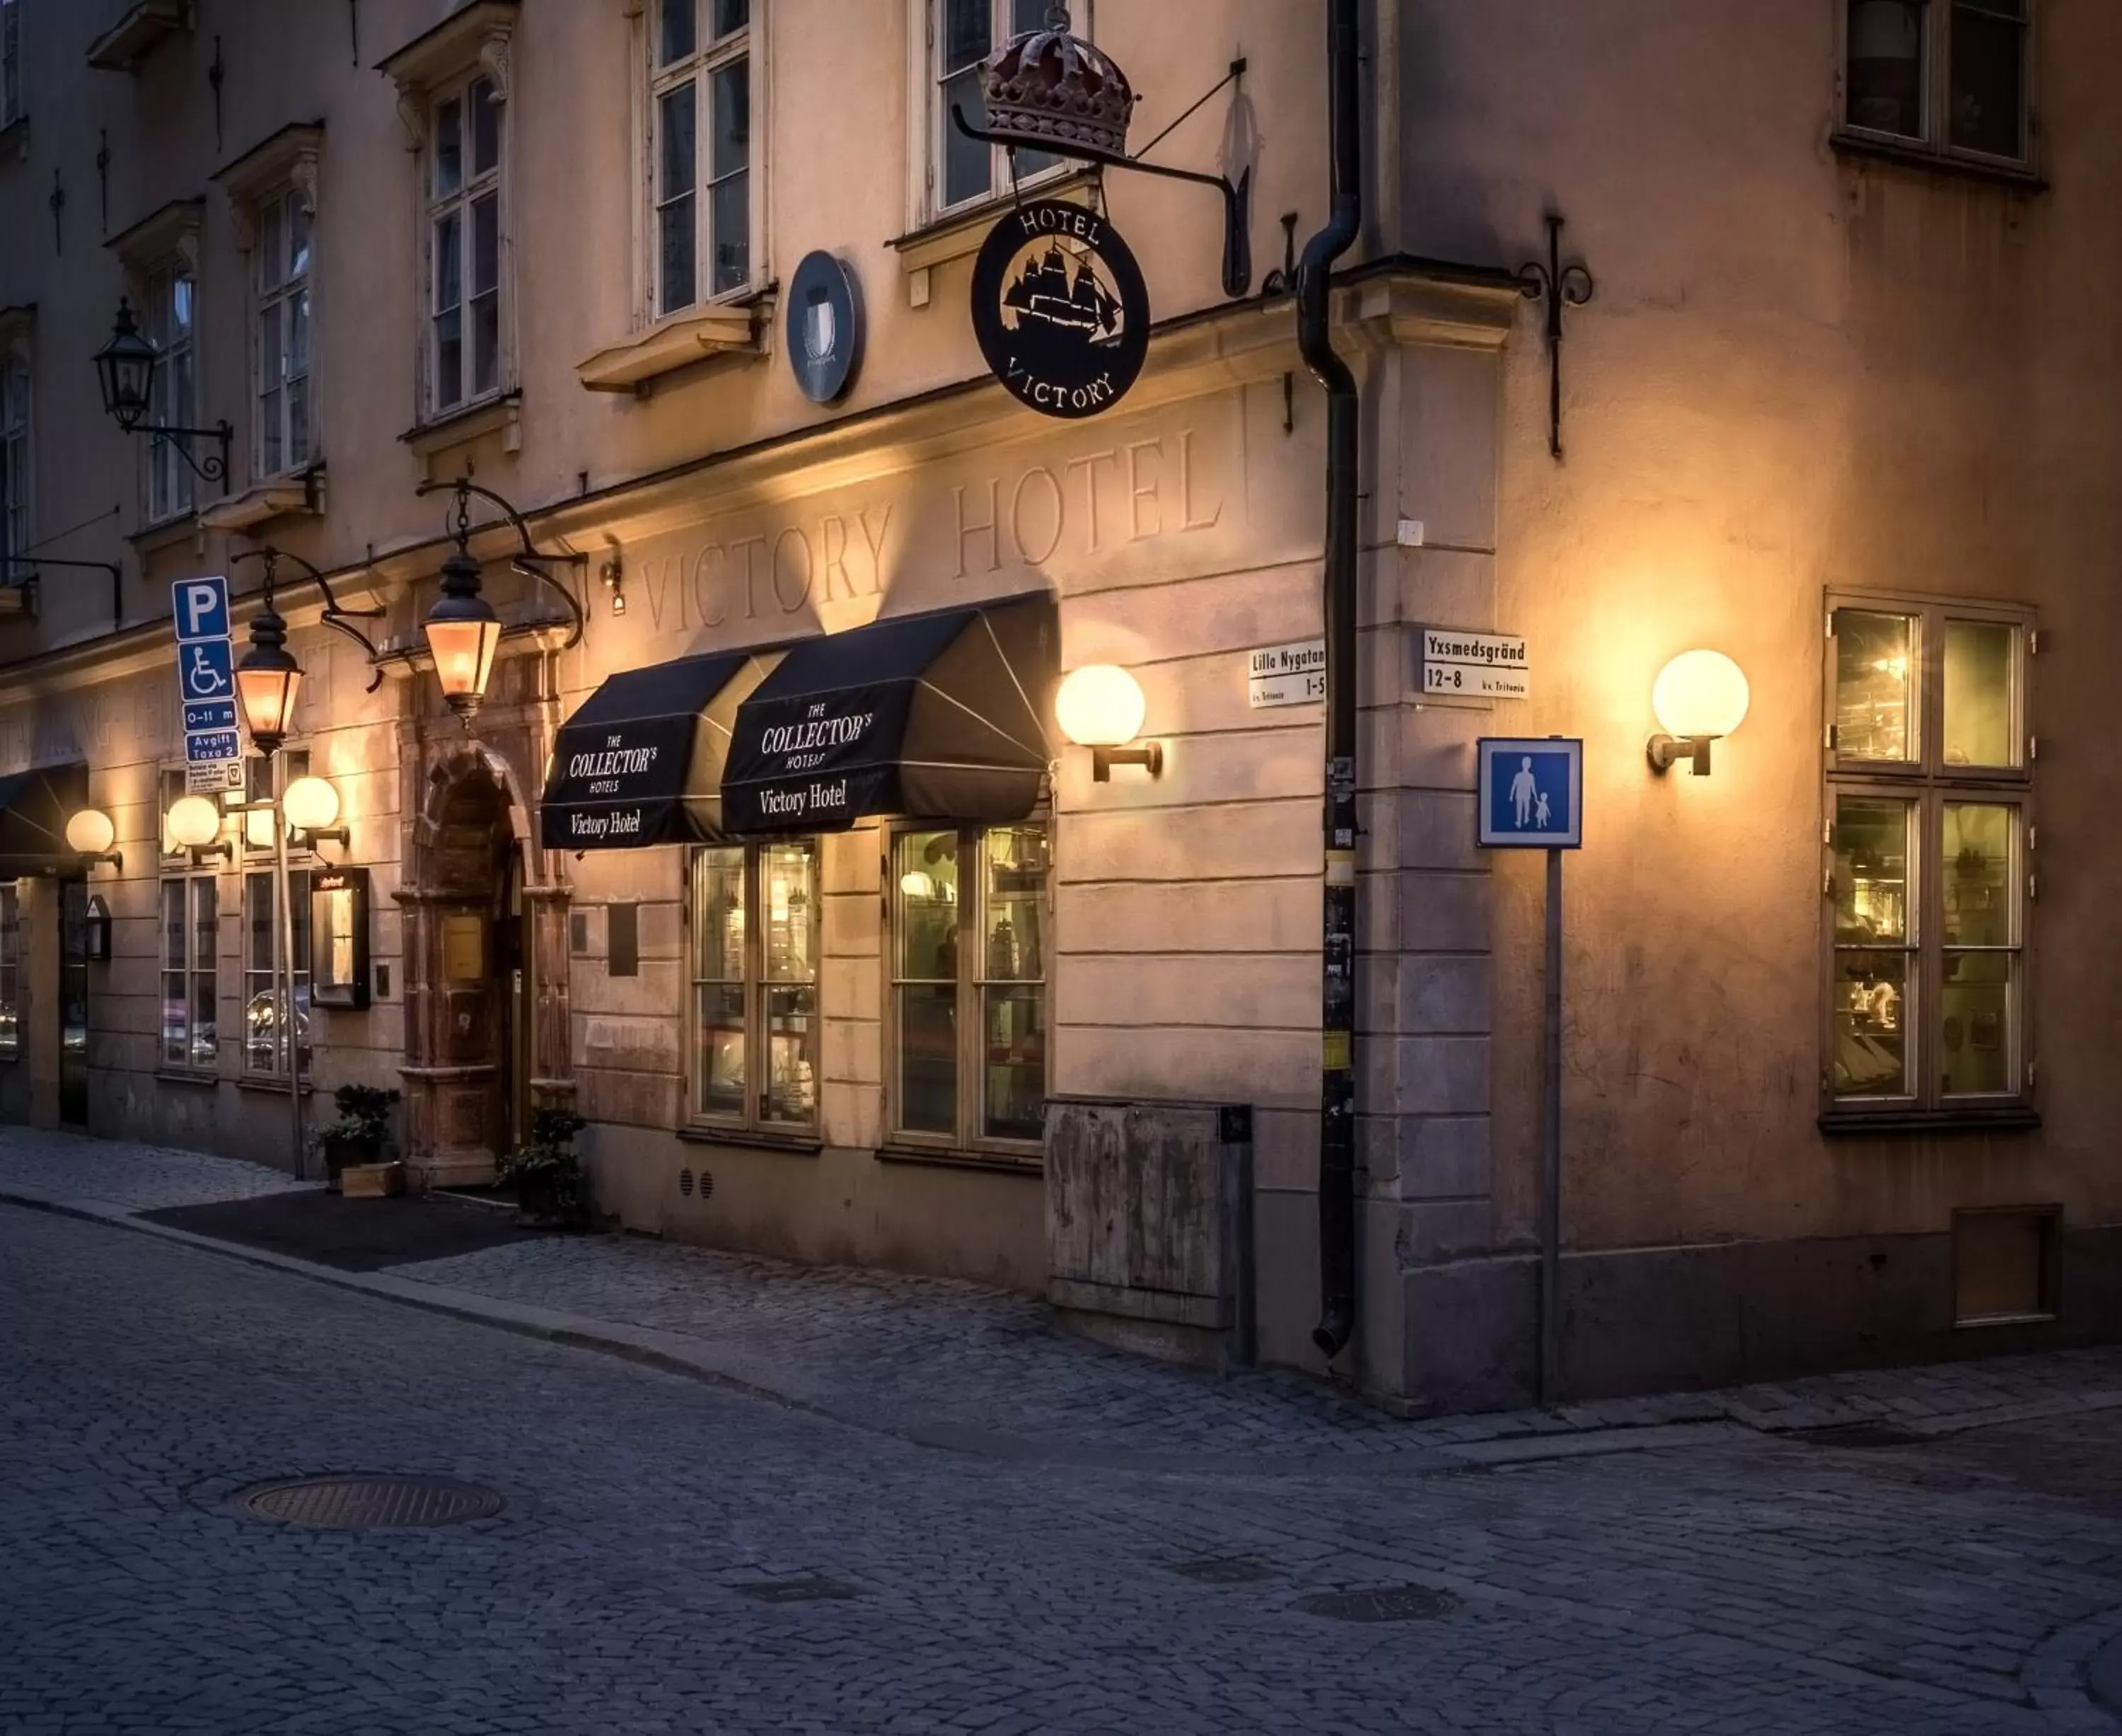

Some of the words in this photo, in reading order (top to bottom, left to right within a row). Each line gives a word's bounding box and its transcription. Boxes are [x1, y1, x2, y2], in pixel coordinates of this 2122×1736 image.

[1020, 208, 1100, 245] HOTEL
[1007, 356, 1115, 409] VICTORY
[639, 502, 893, 632] VICTORY
[951, 428, 1224, 580] HOTEL
[187, 585, 217, 633] P
[1428, 636, 1526, 663] Yxsmedsgränd
[1253, 652, 1276, 671] Lilla
[1281, 649, 1325, 671] Nygatan
[1306, 676, 1325, 696] 1-5
[1428, 668, 1462, 688] 12-8
[223, 710, 233, 720] m
[808, 702, 825, 717] THE
[195, 734, 231, 748] Avgift
[607, 735, 621, 748] THE
[192, 749, 222, 759] Taxa
[226, 746, 234, 756] 2
[786, 753, 826, 770] HOTELS
[589, 780, 620, 794] HOTELS
[760, 787, 806, 816] Victory
[809, 779, 847, 809] Hotel
[571, 813, 610, 840] Victory
[610, 809, 640, 834] Hotel
